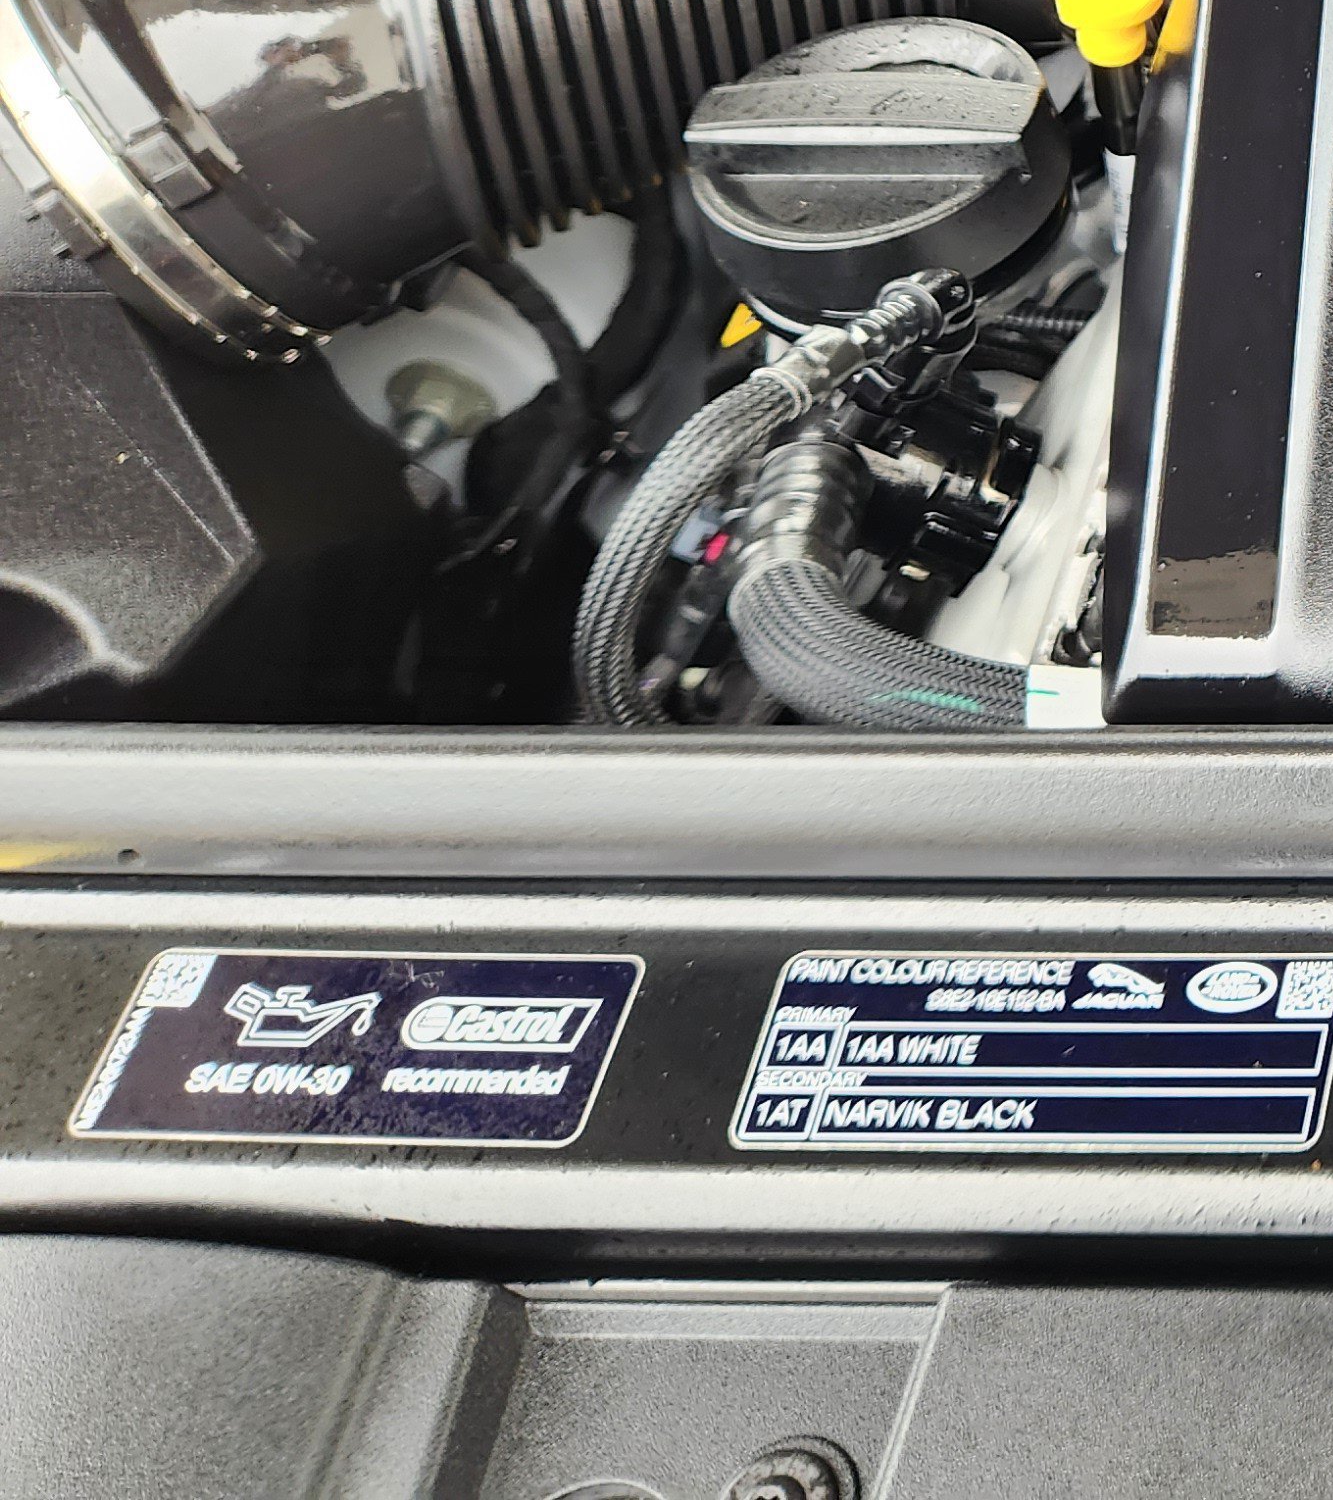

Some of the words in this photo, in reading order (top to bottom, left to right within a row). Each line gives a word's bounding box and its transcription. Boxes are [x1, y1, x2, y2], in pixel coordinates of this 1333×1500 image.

[787, 958, 852, 983] PAINT
[850, 960, 949, 985] COLOUR
[947, 960, 1077, 985] REFERENCE
[774, 1006, 858, 1022] PRIMARY
[1071, 992, 1166, 1010] JAGUAR
[447, 1003, 570, 1042] Castrol
[776, 1034, 827, 1062] 1AA
[847, 1034, 896, 1063] 1AA
[896, 1035, 982, 1064] WHITE
[184, 1063, 252, 1093] SAE
[253, 1065, 352, 1095] 0W-30
[381, 1065, 572, 1095] recommended
[755, 1071, 869, 1087] SECONDARY
[755, 1099, 810, 1127] 1AT
[821, 1100, 935, 1129] NARVIK
[934, 1100, 1038, 1130] BLACK
